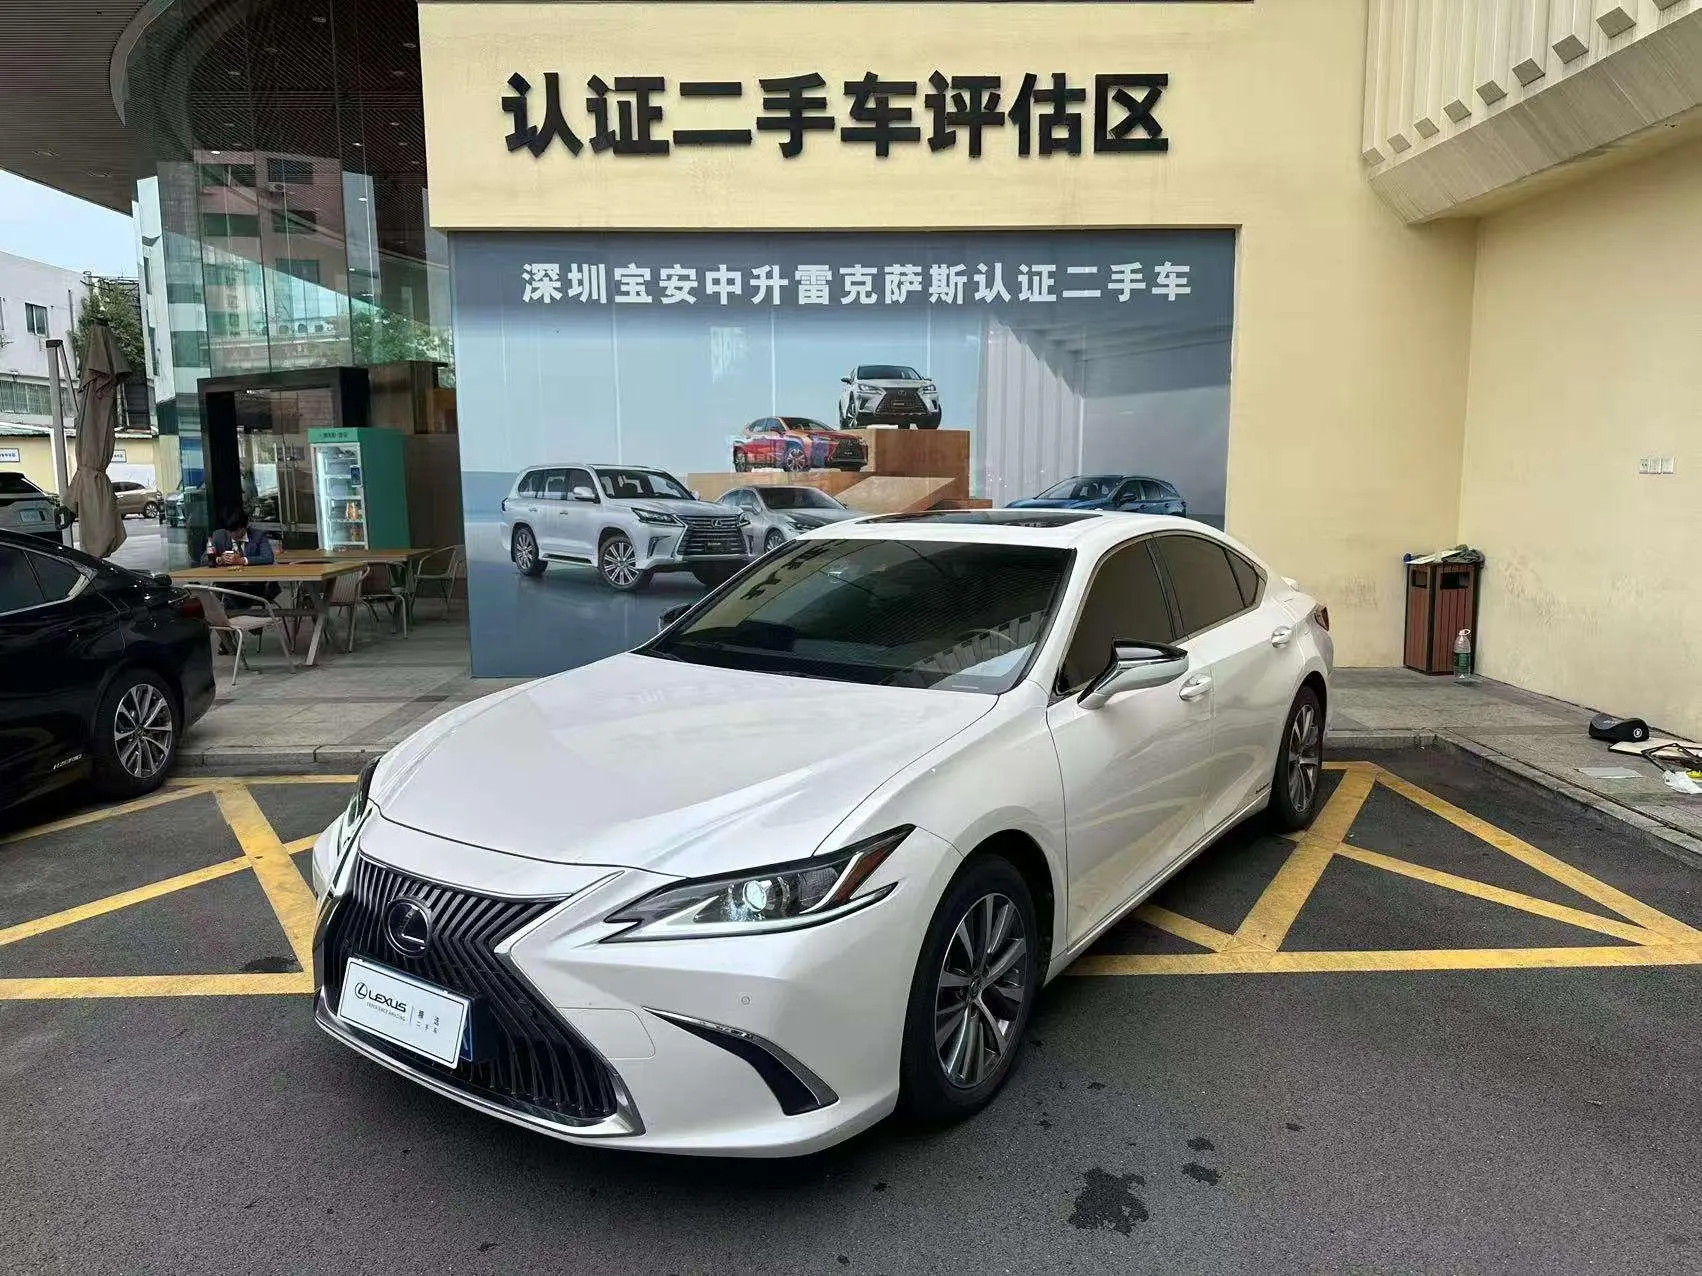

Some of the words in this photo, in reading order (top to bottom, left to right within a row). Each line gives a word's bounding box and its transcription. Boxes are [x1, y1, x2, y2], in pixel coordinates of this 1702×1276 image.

[502, 71, 1168, 158] 认证二手车评估区
[521, 261, 1192, 304] 深圳宝安中升雷克萨斯认证二手车
[368, 990, 407, 1013] LEXUS
